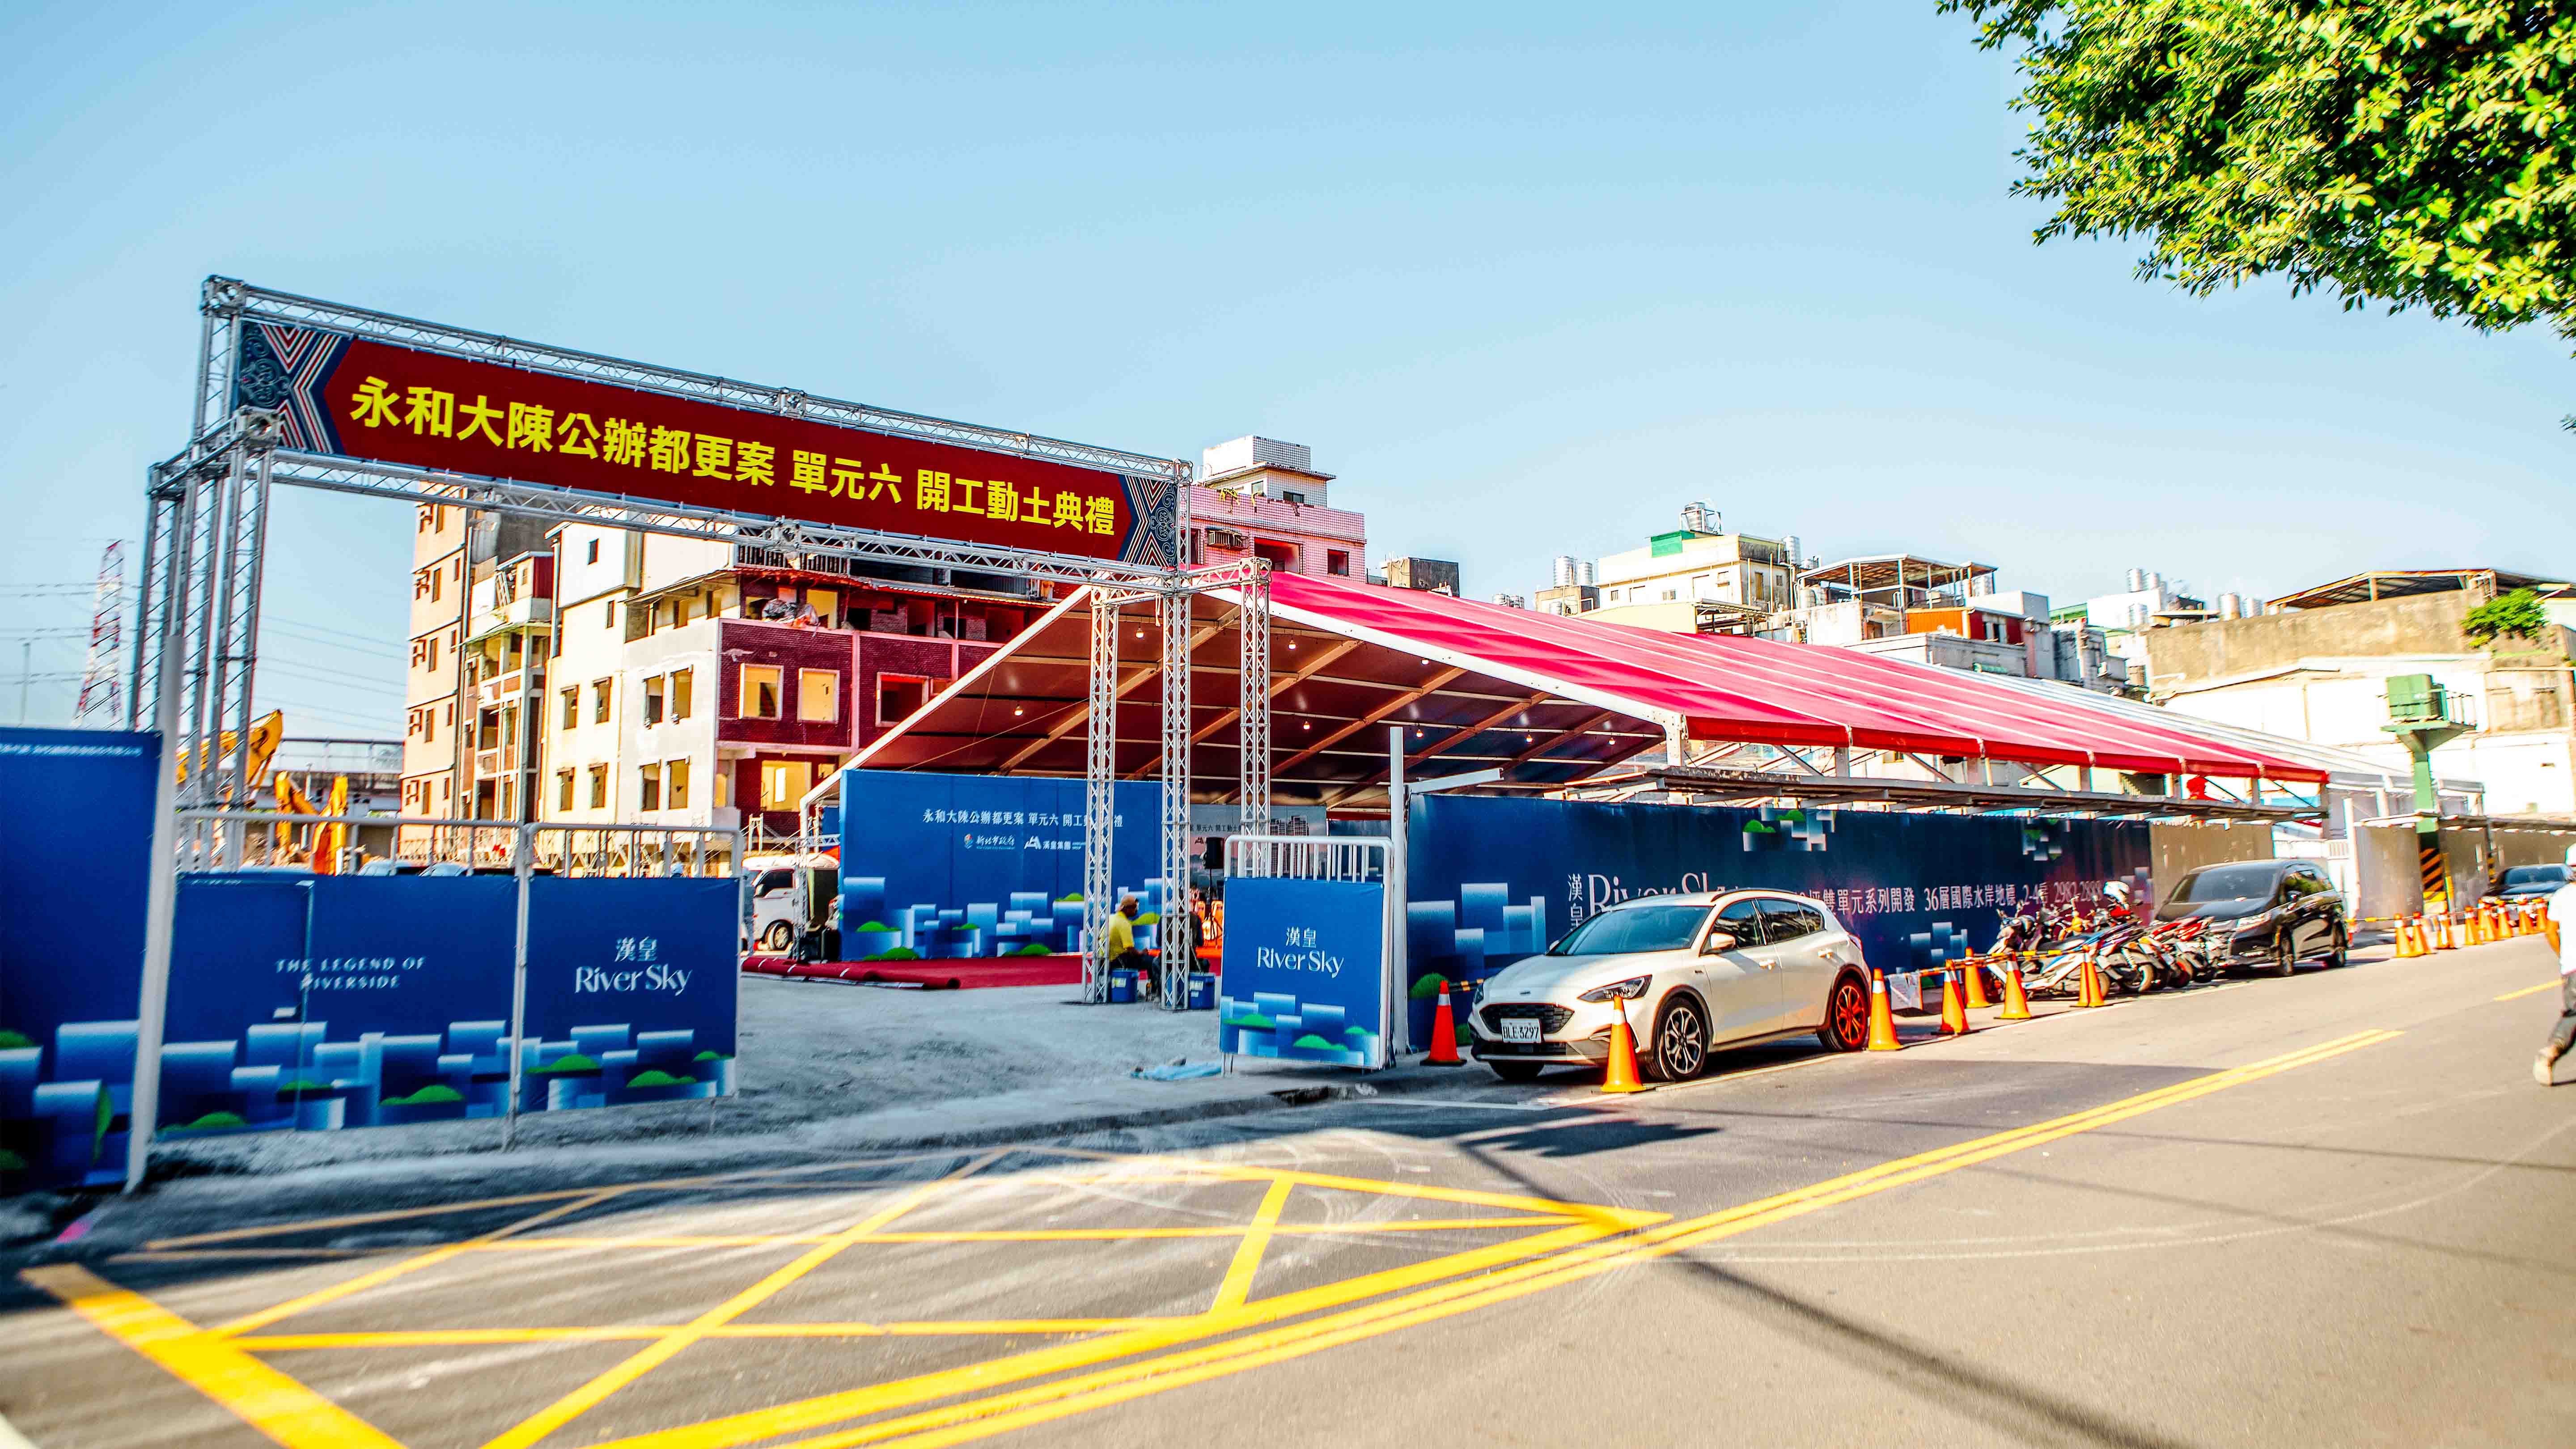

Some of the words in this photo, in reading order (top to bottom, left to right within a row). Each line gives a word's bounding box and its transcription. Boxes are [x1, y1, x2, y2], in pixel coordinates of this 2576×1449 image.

[350, 376, 775, 487] 永和大陳公辦都更案
[790, 450, 902, 504] 單元六
[917, 470, 1115, 536] 開工動土典禮
[923, 809, 1024, 825] 永和大陳公辦都更案
[1028, 813, 1059, 826] 單元六
[1063, 813, 1123, 827] 開工禮
[614, 936, 657, 962] 漢皇
[1285, 926, 1317, 948] 漢皇
[275, 958, 312, 973] THE
[320, 957, 395, 972] LEGEND
[402, 956, 426, 970] OF
[1257, 946, 1306, 970] River
[1309, 950, 1344, 979] Sky
[300, 973, 400, 991] RIVERSIDE
[575, 966, 644, 993] River
[645, 963, 693, 996] Sky
